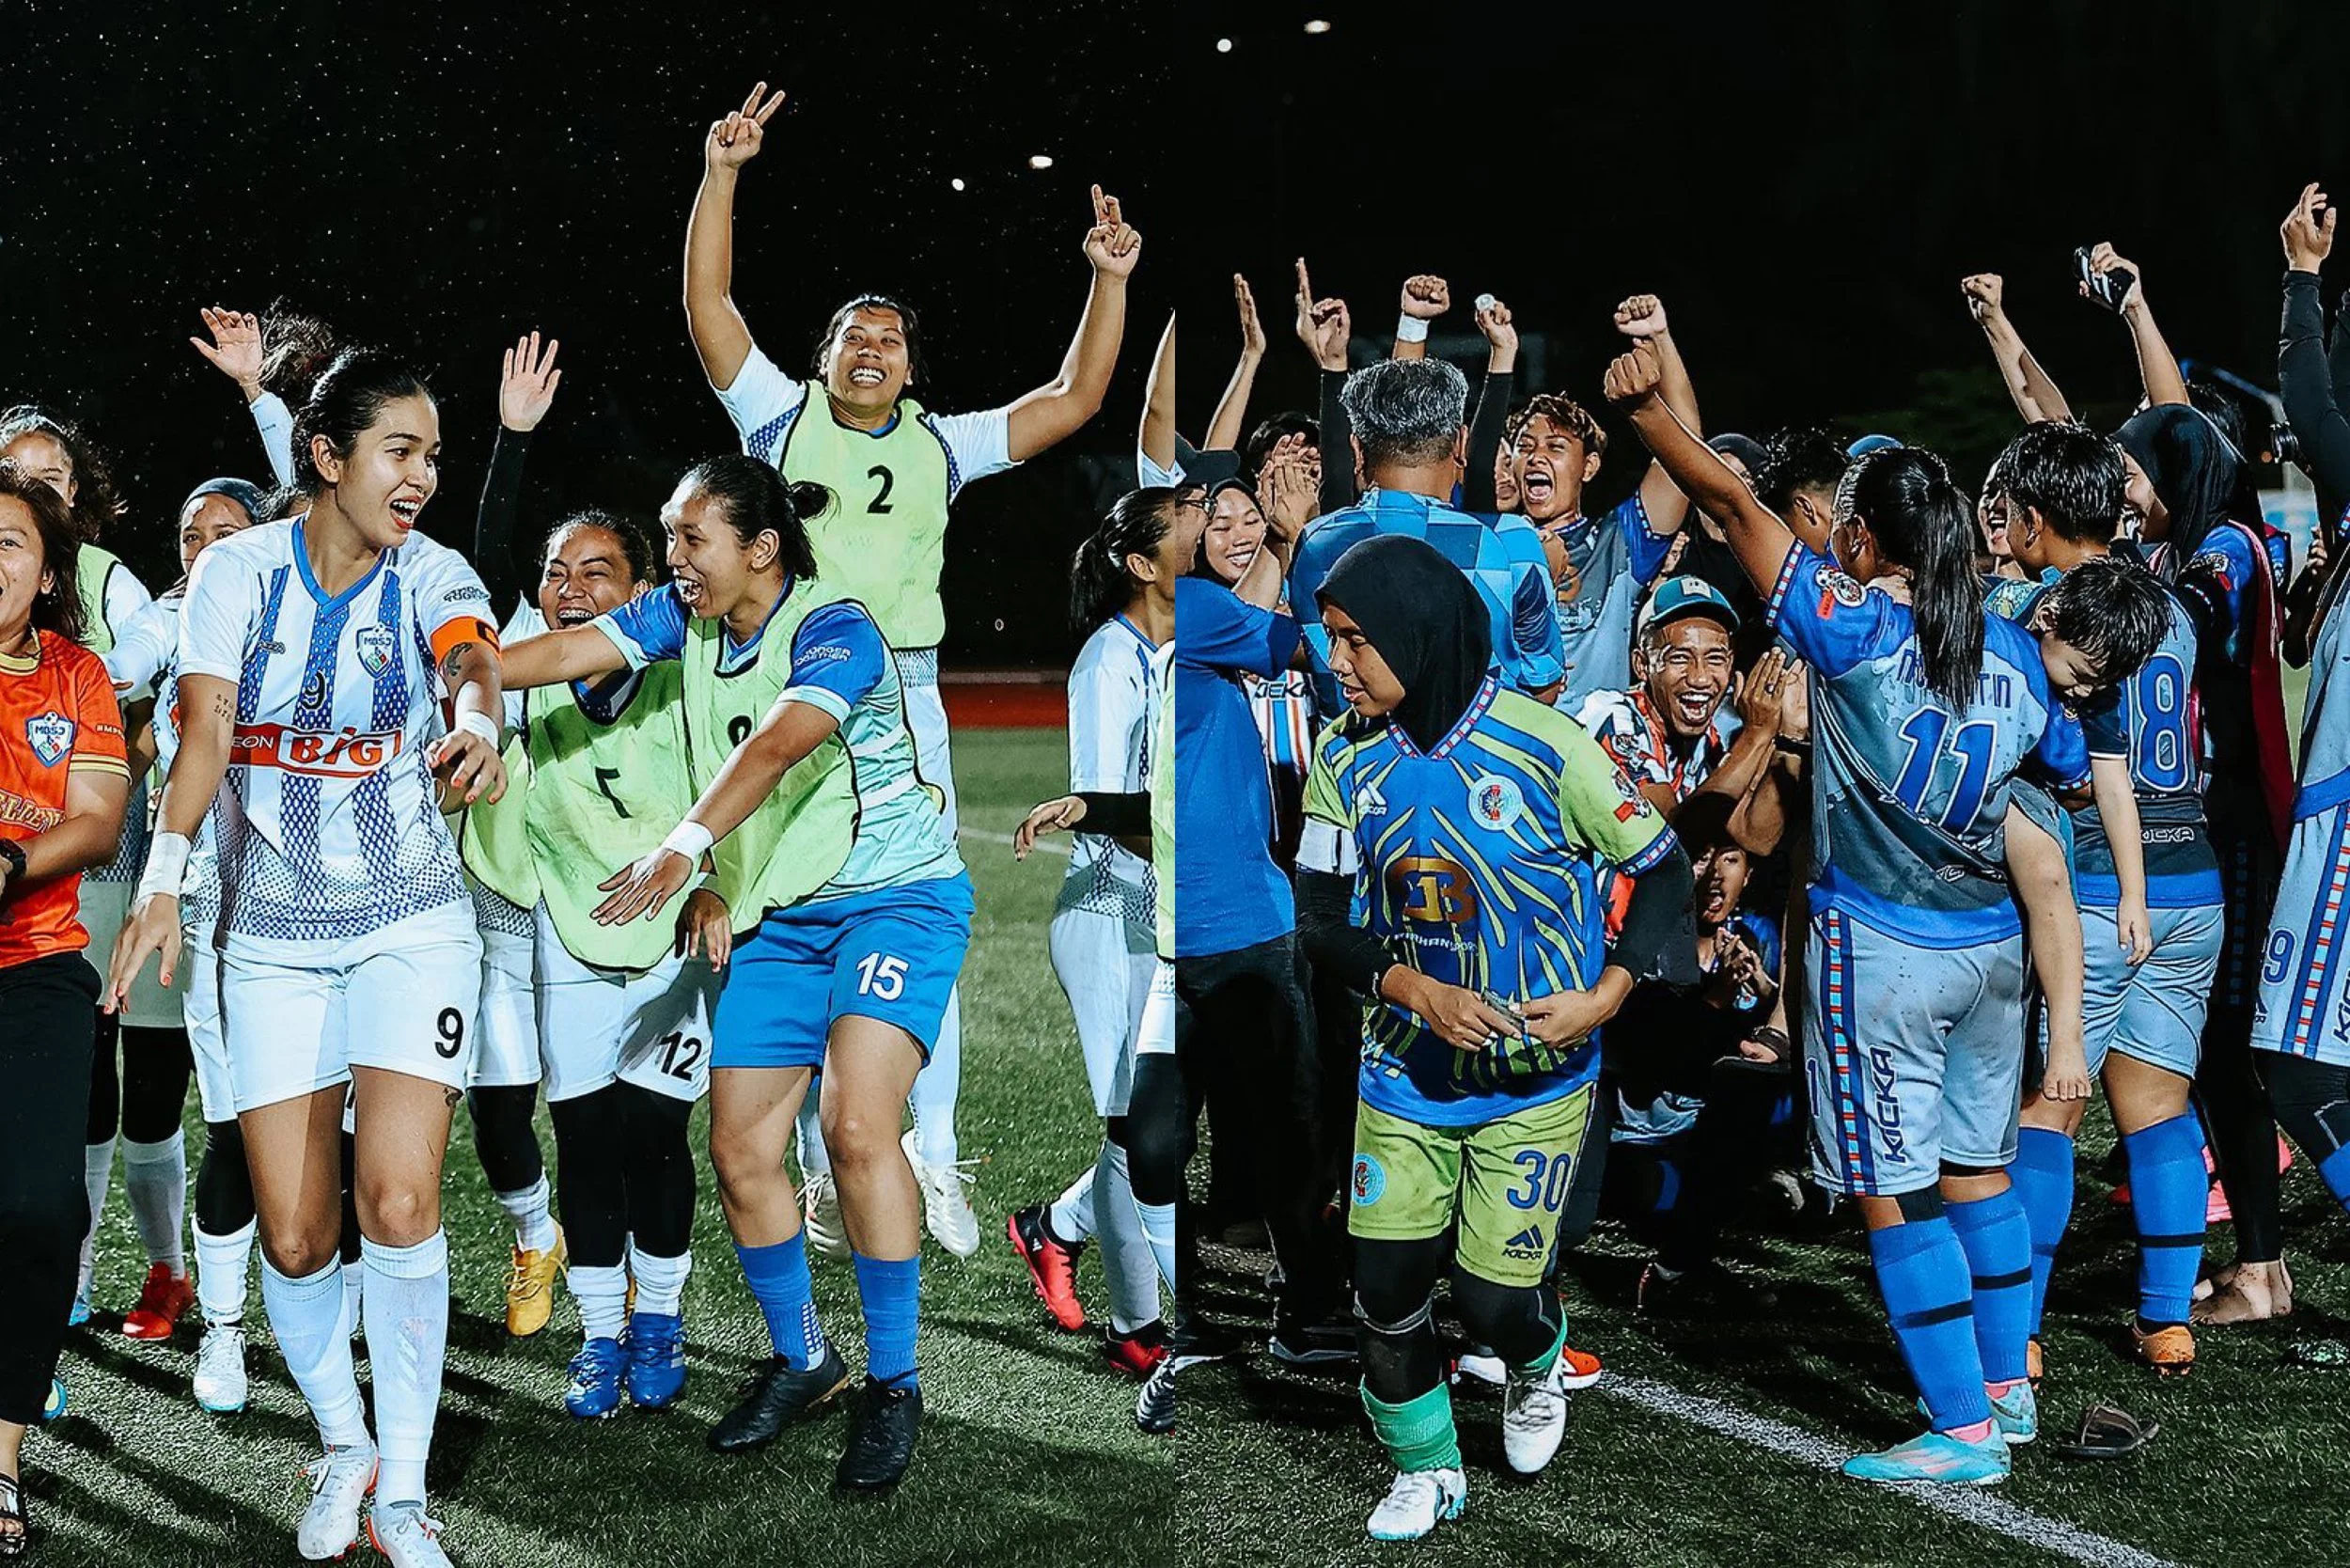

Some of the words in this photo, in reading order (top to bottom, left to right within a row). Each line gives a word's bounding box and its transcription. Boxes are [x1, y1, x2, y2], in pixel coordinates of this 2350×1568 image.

[867, 464, 894, 514] 2
[302, 669, 326, 711] 9
[232, 735, 274, 749] EON
[1898, 704, 1998, 839] 11
[856, 952, 910, 1001] 15
[2262, 928, 2296, 985] 9
[434, 1007, 463, 1058] 9
[658, 1031, 702, 1081] 12
[1869, 1044, 1908, 1166] KICKA
[1506, 1149, 1572, 1213] 30
